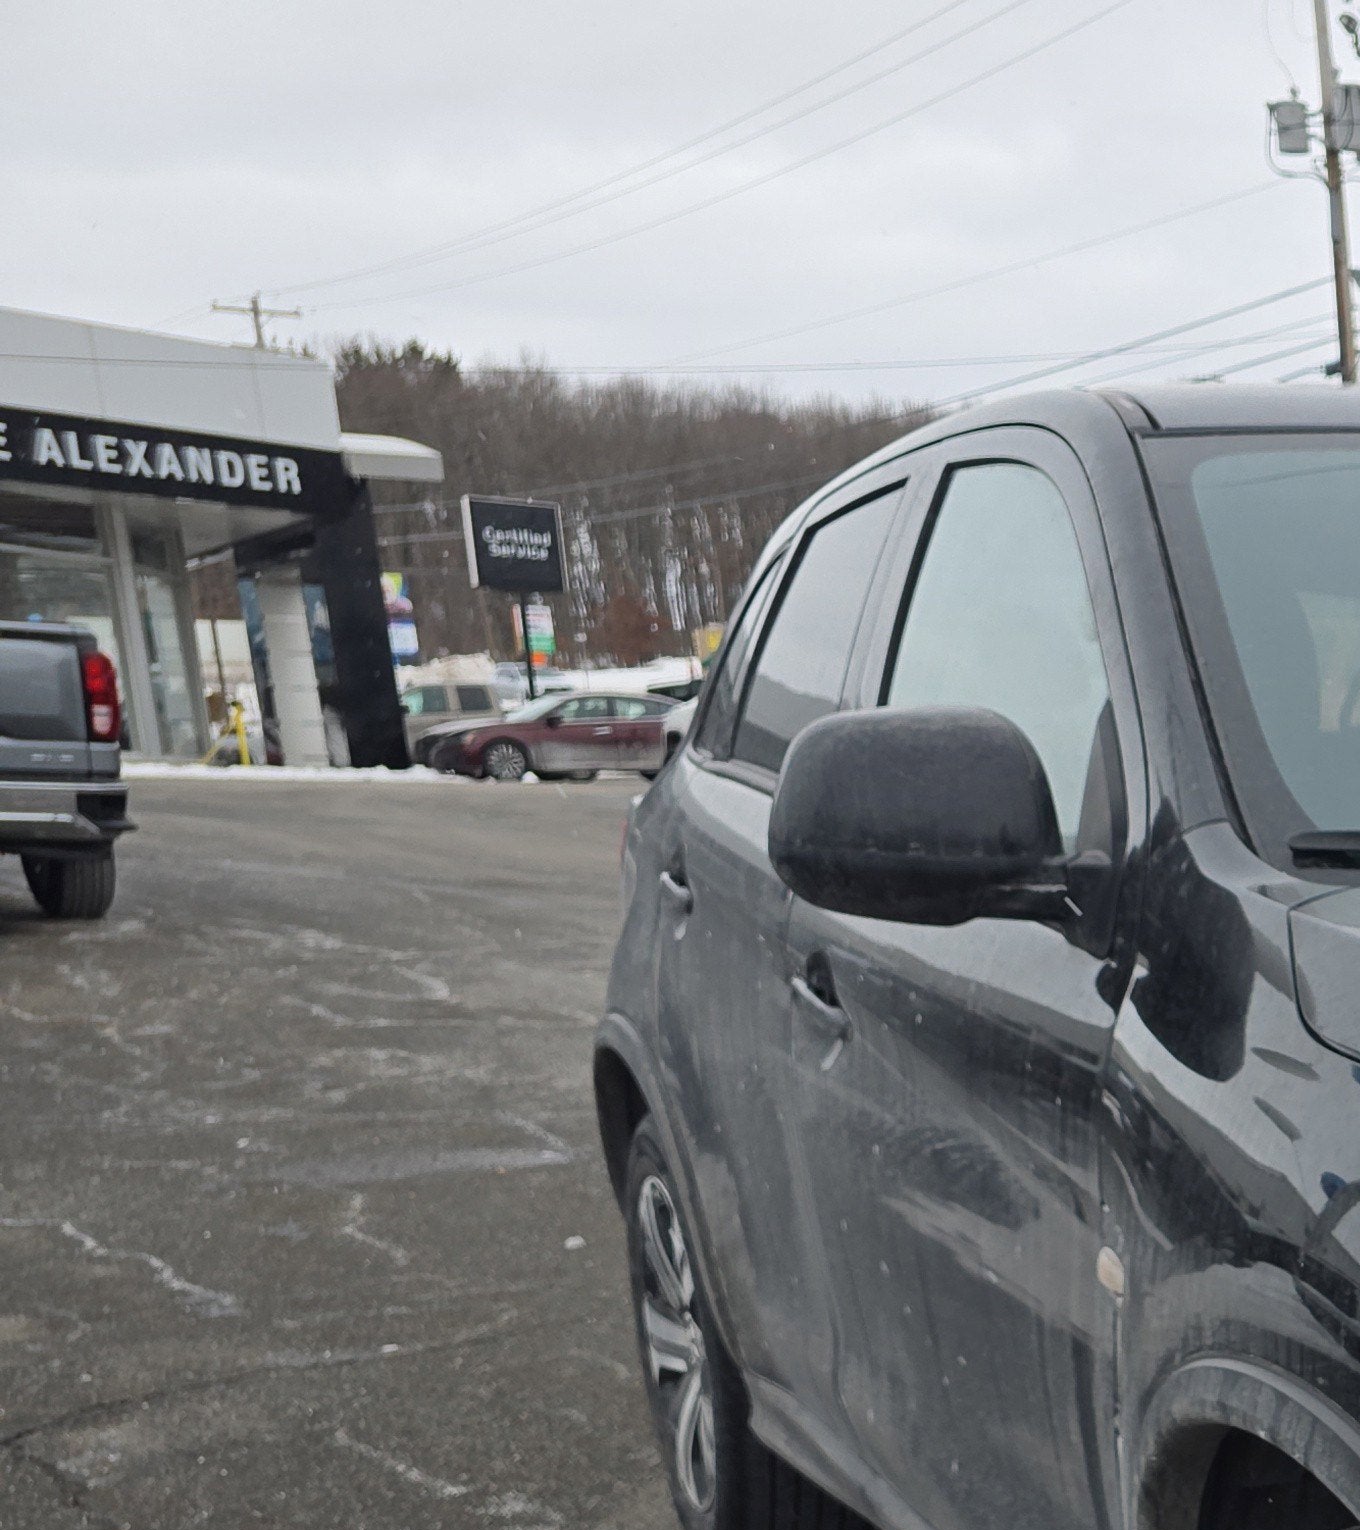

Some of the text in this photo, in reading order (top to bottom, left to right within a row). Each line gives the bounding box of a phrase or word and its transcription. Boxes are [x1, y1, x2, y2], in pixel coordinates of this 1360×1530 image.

[33, 427, 302, 494] ALEXANDER
[482, 525, 552, 547] Certified
[488, 543, 549, 561] Service
